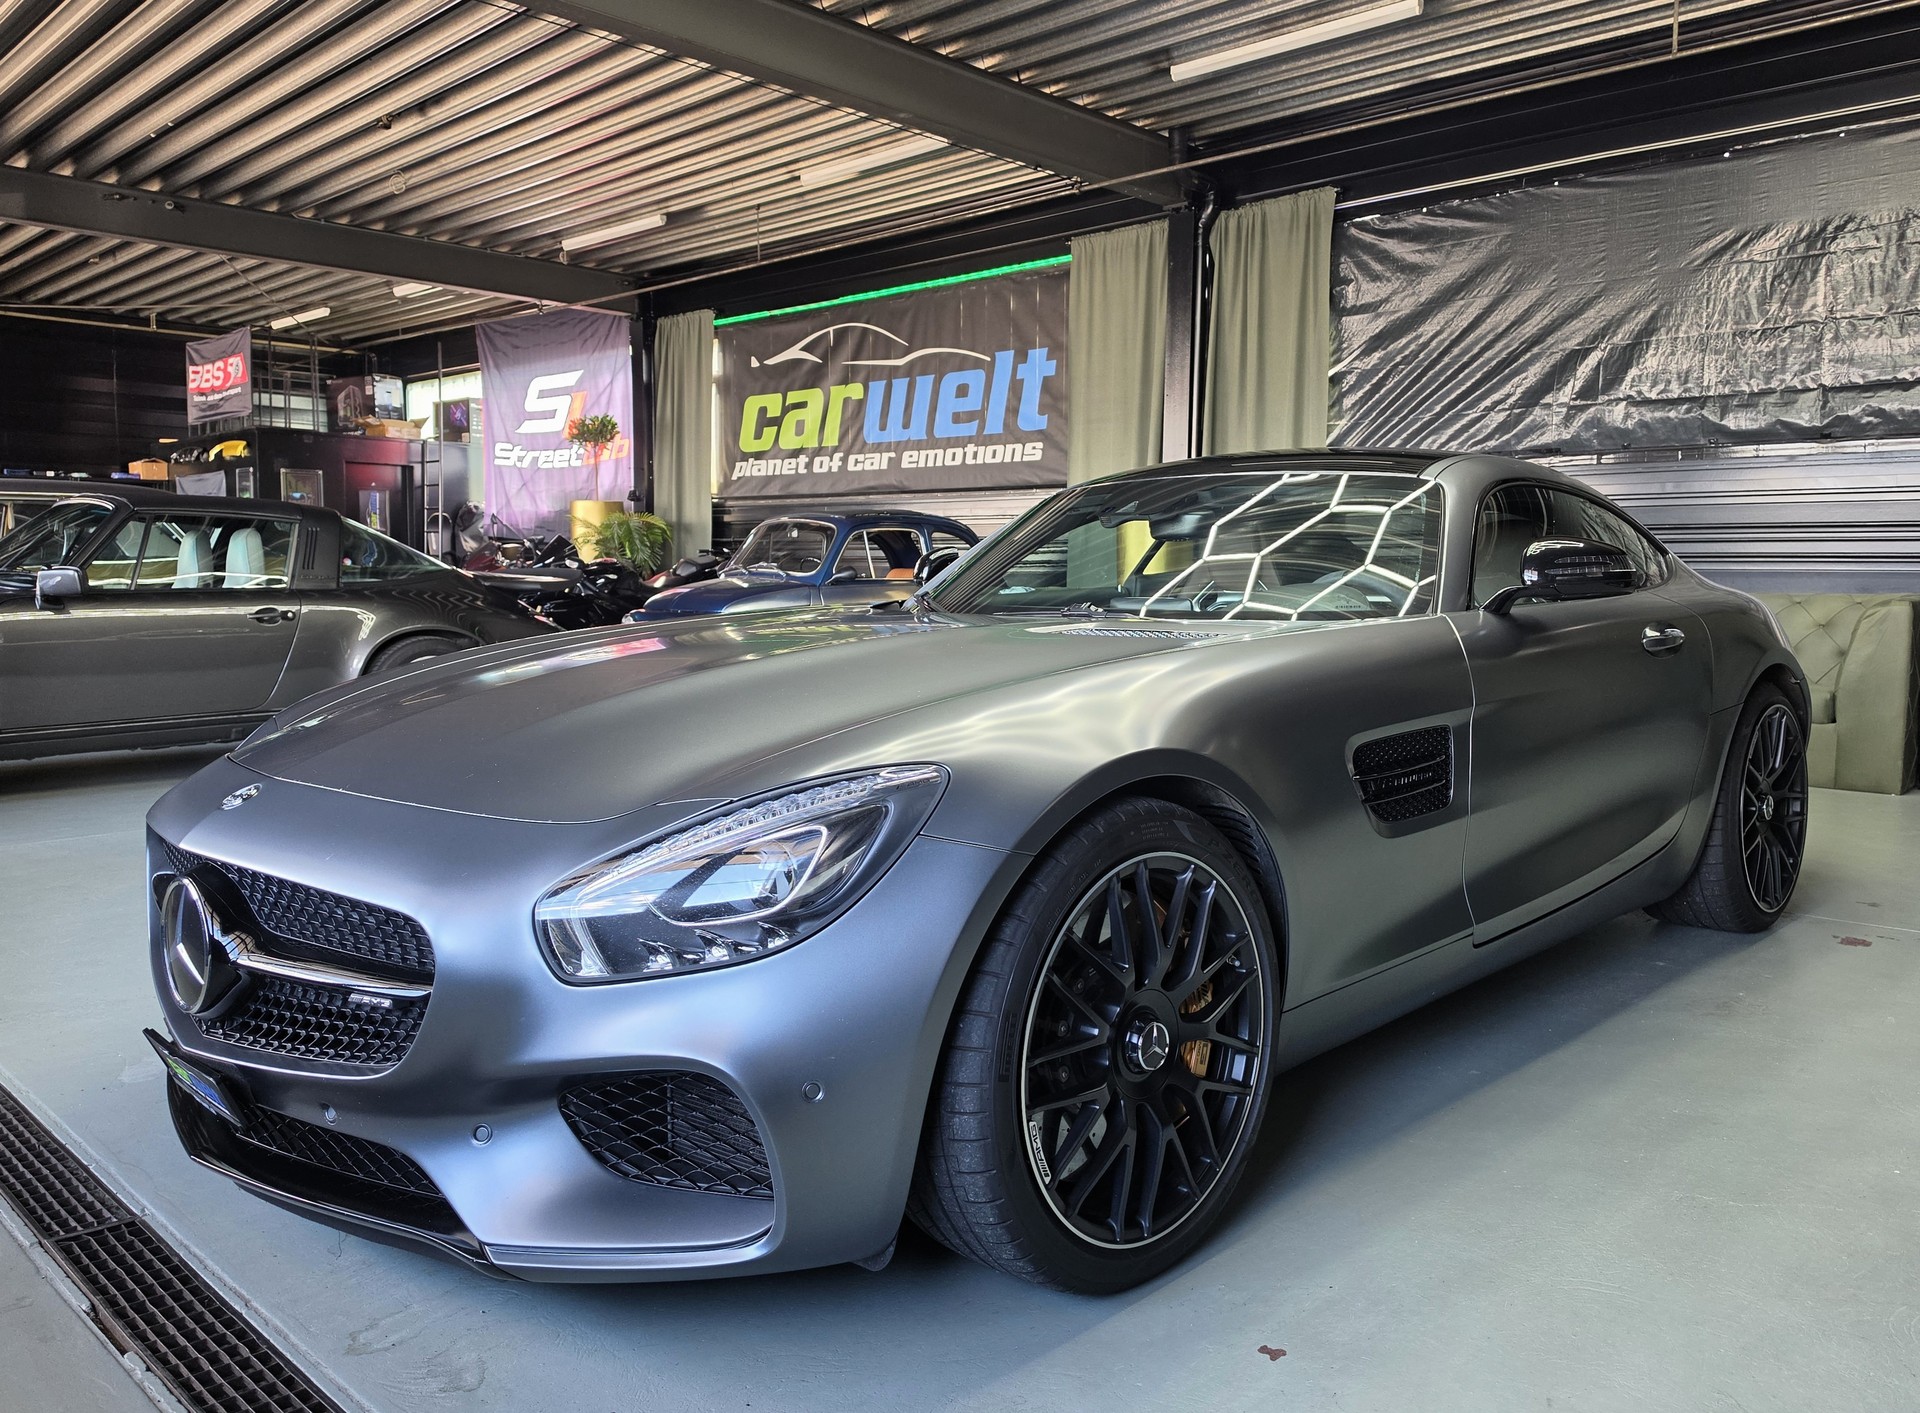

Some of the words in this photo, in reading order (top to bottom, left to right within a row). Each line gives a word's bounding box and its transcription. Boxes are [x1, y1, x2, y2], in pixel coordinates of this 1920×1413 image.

[189, 360, 224, 388] BBS
[738, 347, 1057, 453] carwelt
[731, 455, 809, 480] planet
[812, 452, 844, 474] of
[847, 451, 896, 472] car
[901, 441, 1044, 469] emotions
